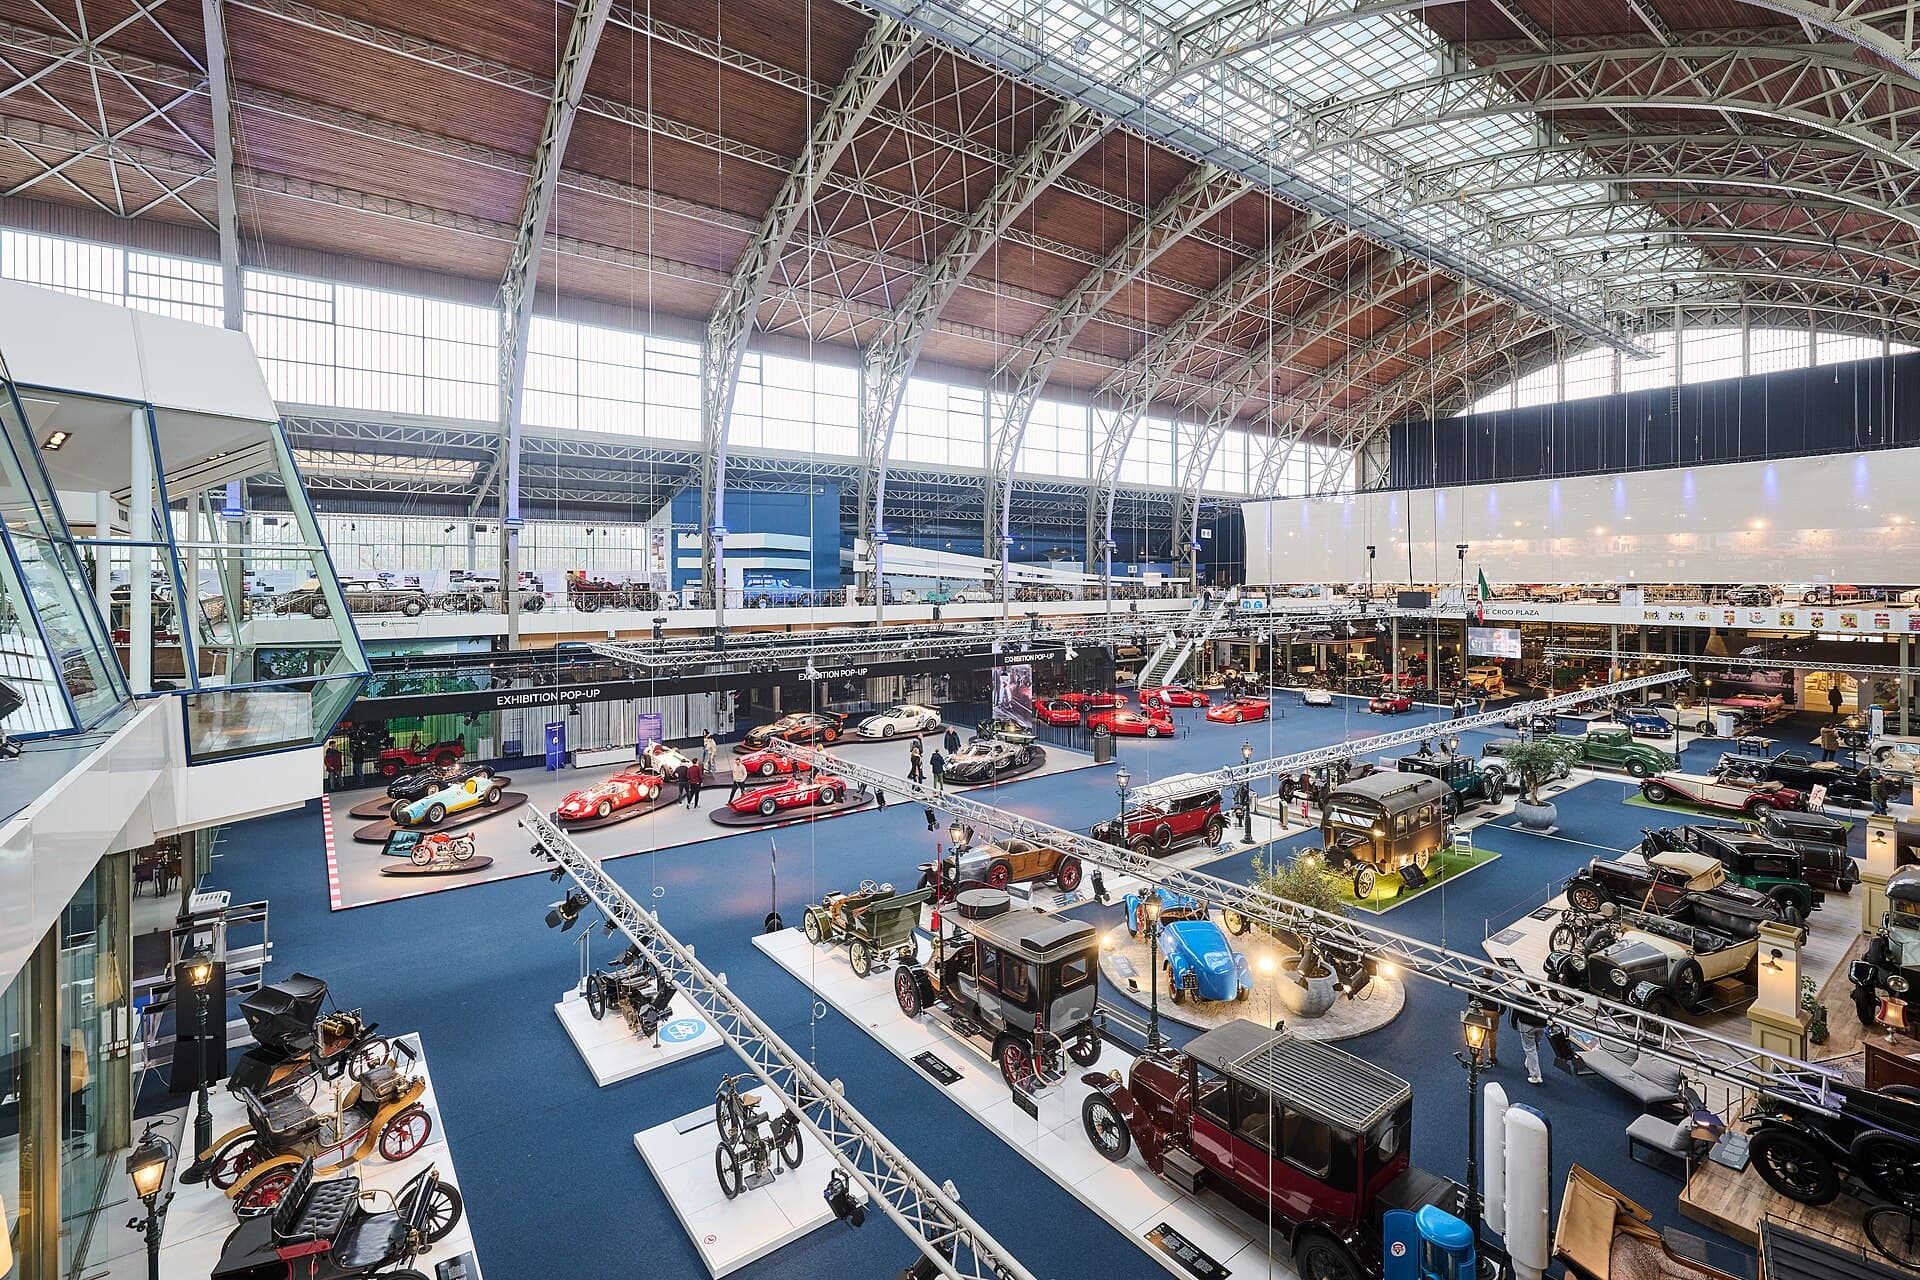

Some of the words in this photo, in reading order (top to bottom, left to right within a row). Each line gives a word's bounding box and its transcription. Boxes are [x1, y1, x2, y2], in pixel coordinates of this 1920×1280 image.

[1035, 653, 1055, 661] POP-UP
[798, 670, 840, 681] EXBITION
[840, 668, 868, 677] POP-UP
[497, 692, 558, 706] EXHIBITION
[560, 689, 601, 700] POP-UP
